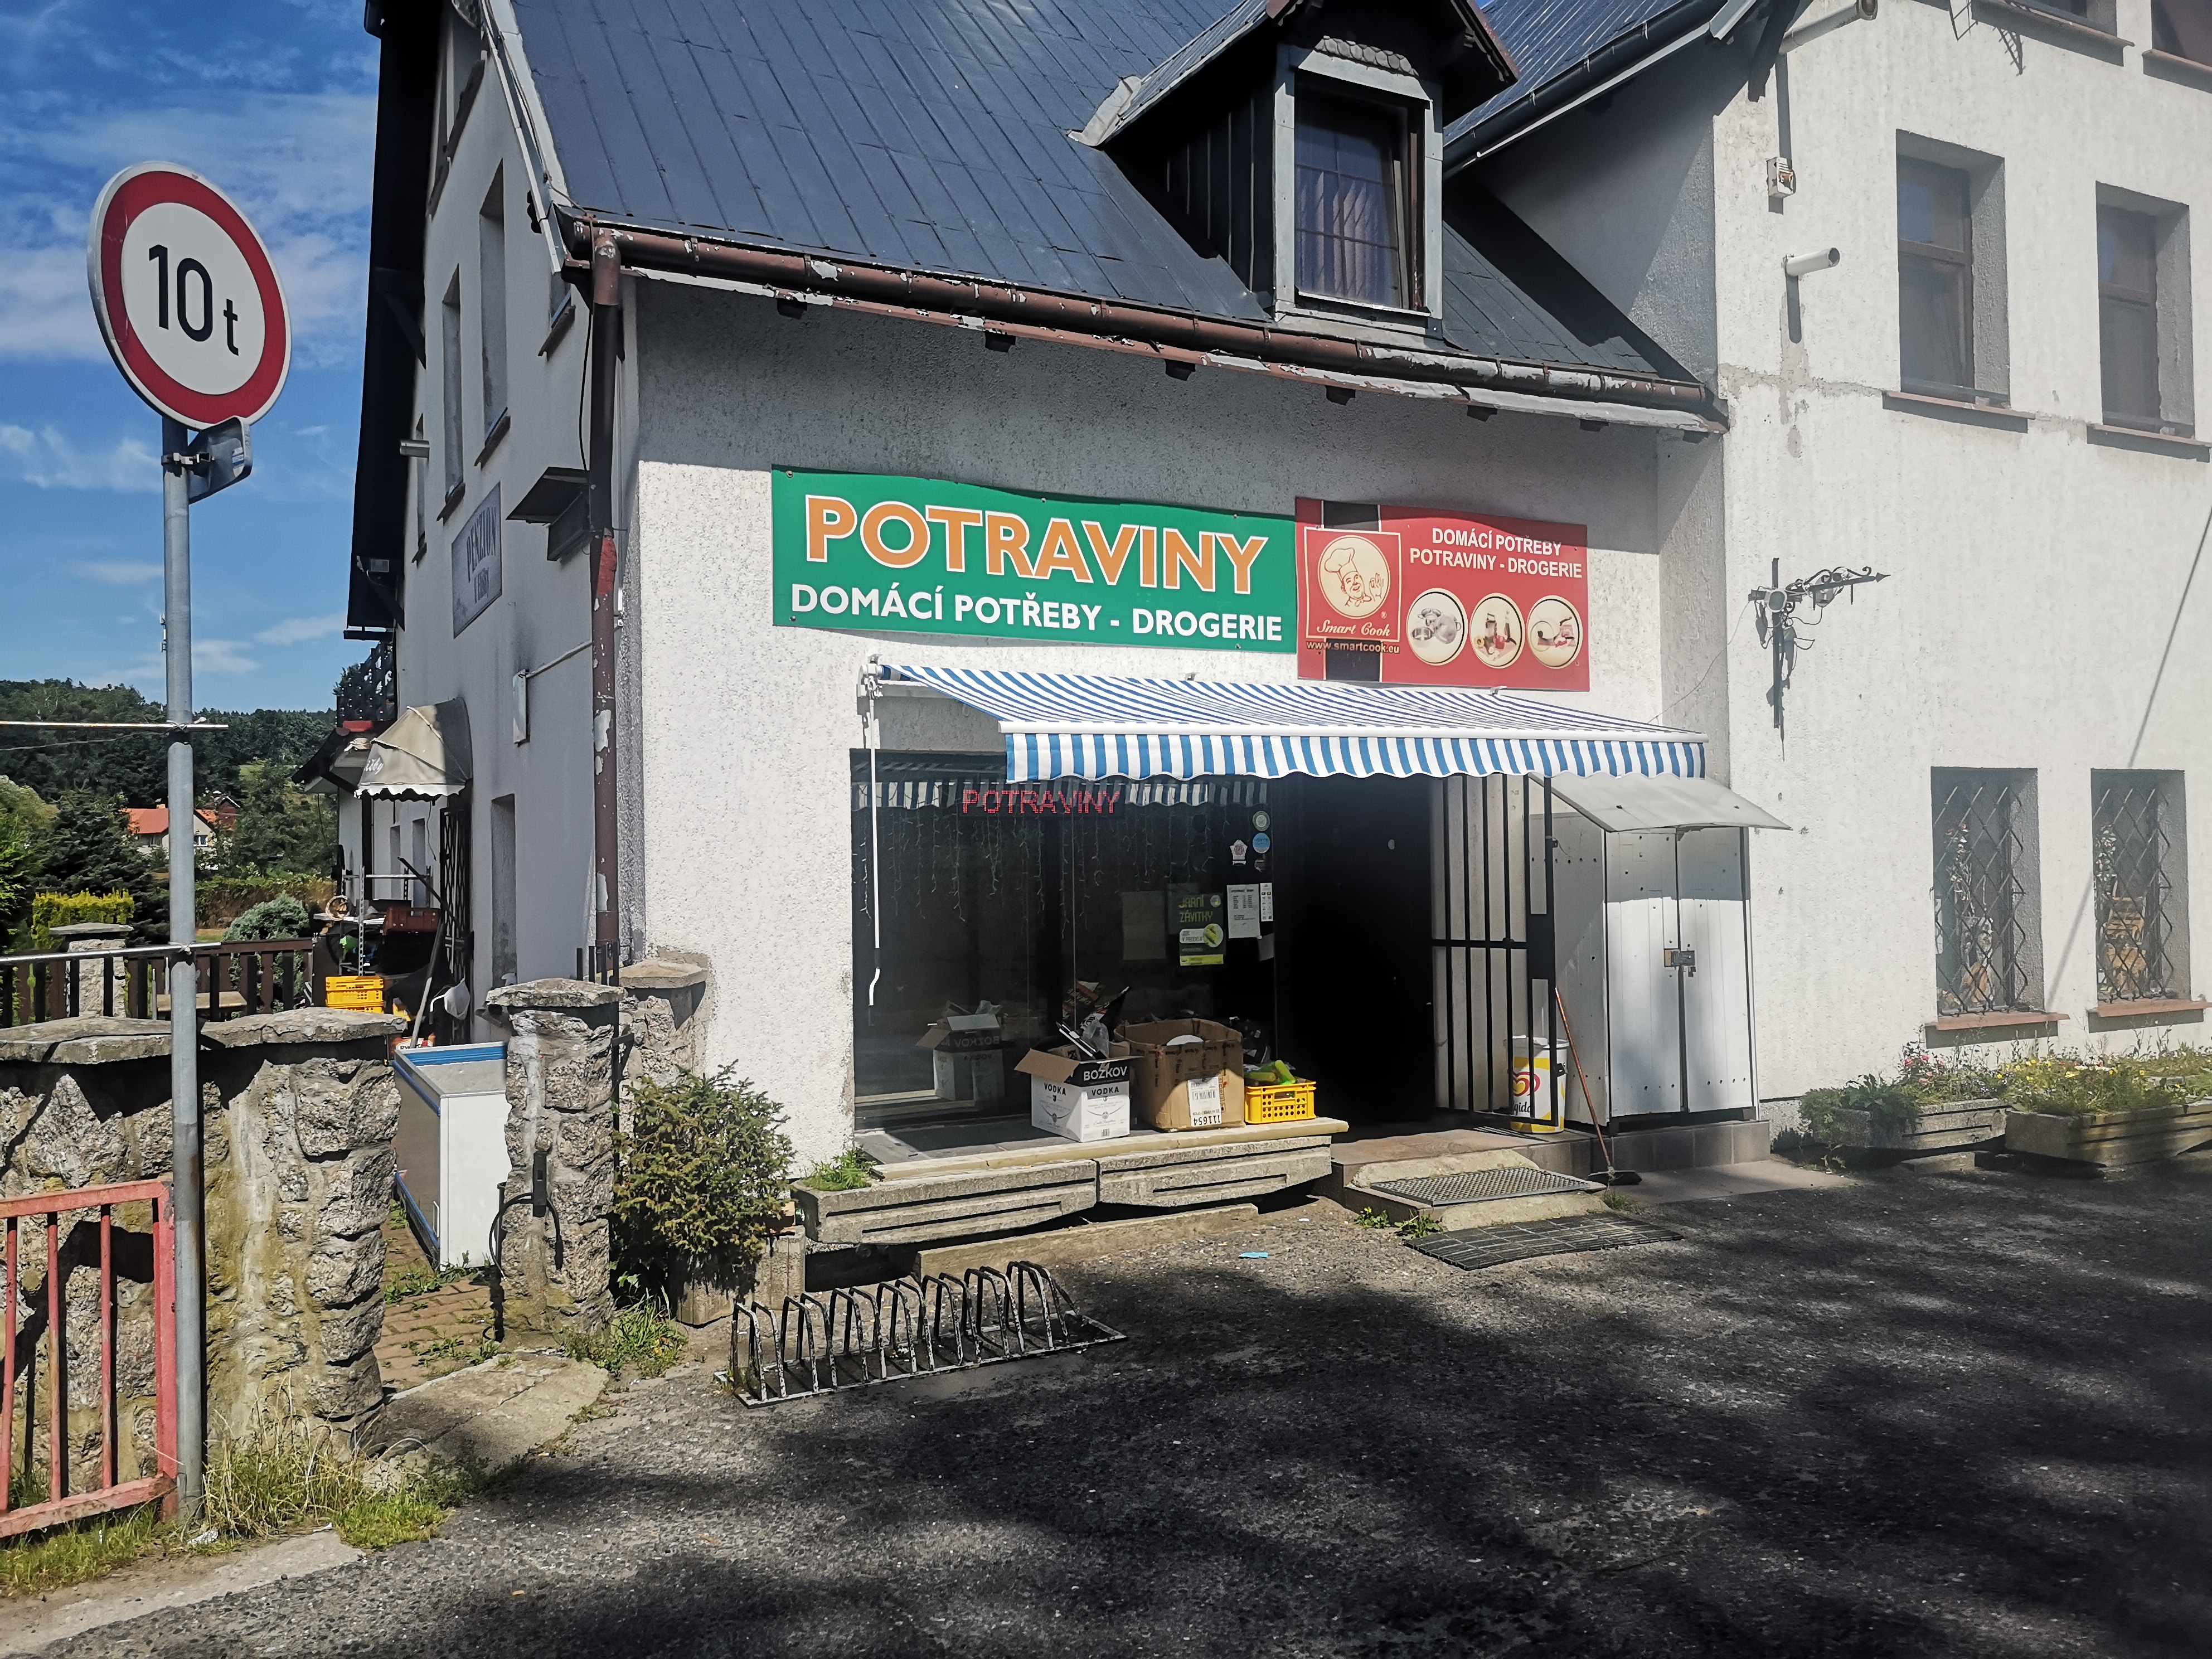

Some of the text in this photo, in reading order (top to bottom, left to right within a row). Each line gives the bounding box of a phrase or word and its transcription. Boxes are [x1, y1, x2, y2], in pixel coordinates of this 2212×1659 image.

[804, 494, 1269, 595] POTRAVINY
[1432, 528, 1562, 556] DOMÁCÍ POTŘEBY
[1410, 547, 1497, 571] POTRAVINY
[1508, 557, 1583, 578] DROGERIE
[792, 582, 944, 620] DOMÁCÍ
[955, 591, 1102, 630] POTŘEBY
[1132, 608, 1282, 641] DROGERIE
[1316, 619, 1391, 637] Smart Cook
[1306, 641, 1400, 654] www.smartcook.eu
[963, 789, 1120, 814] POTRAVINY
[1083, 1065, 1128, 1081] BOZKOV
[1044, 1082, 1066, 1096] VODKA
[1091, 1086, 1119, 1096] VODKA
